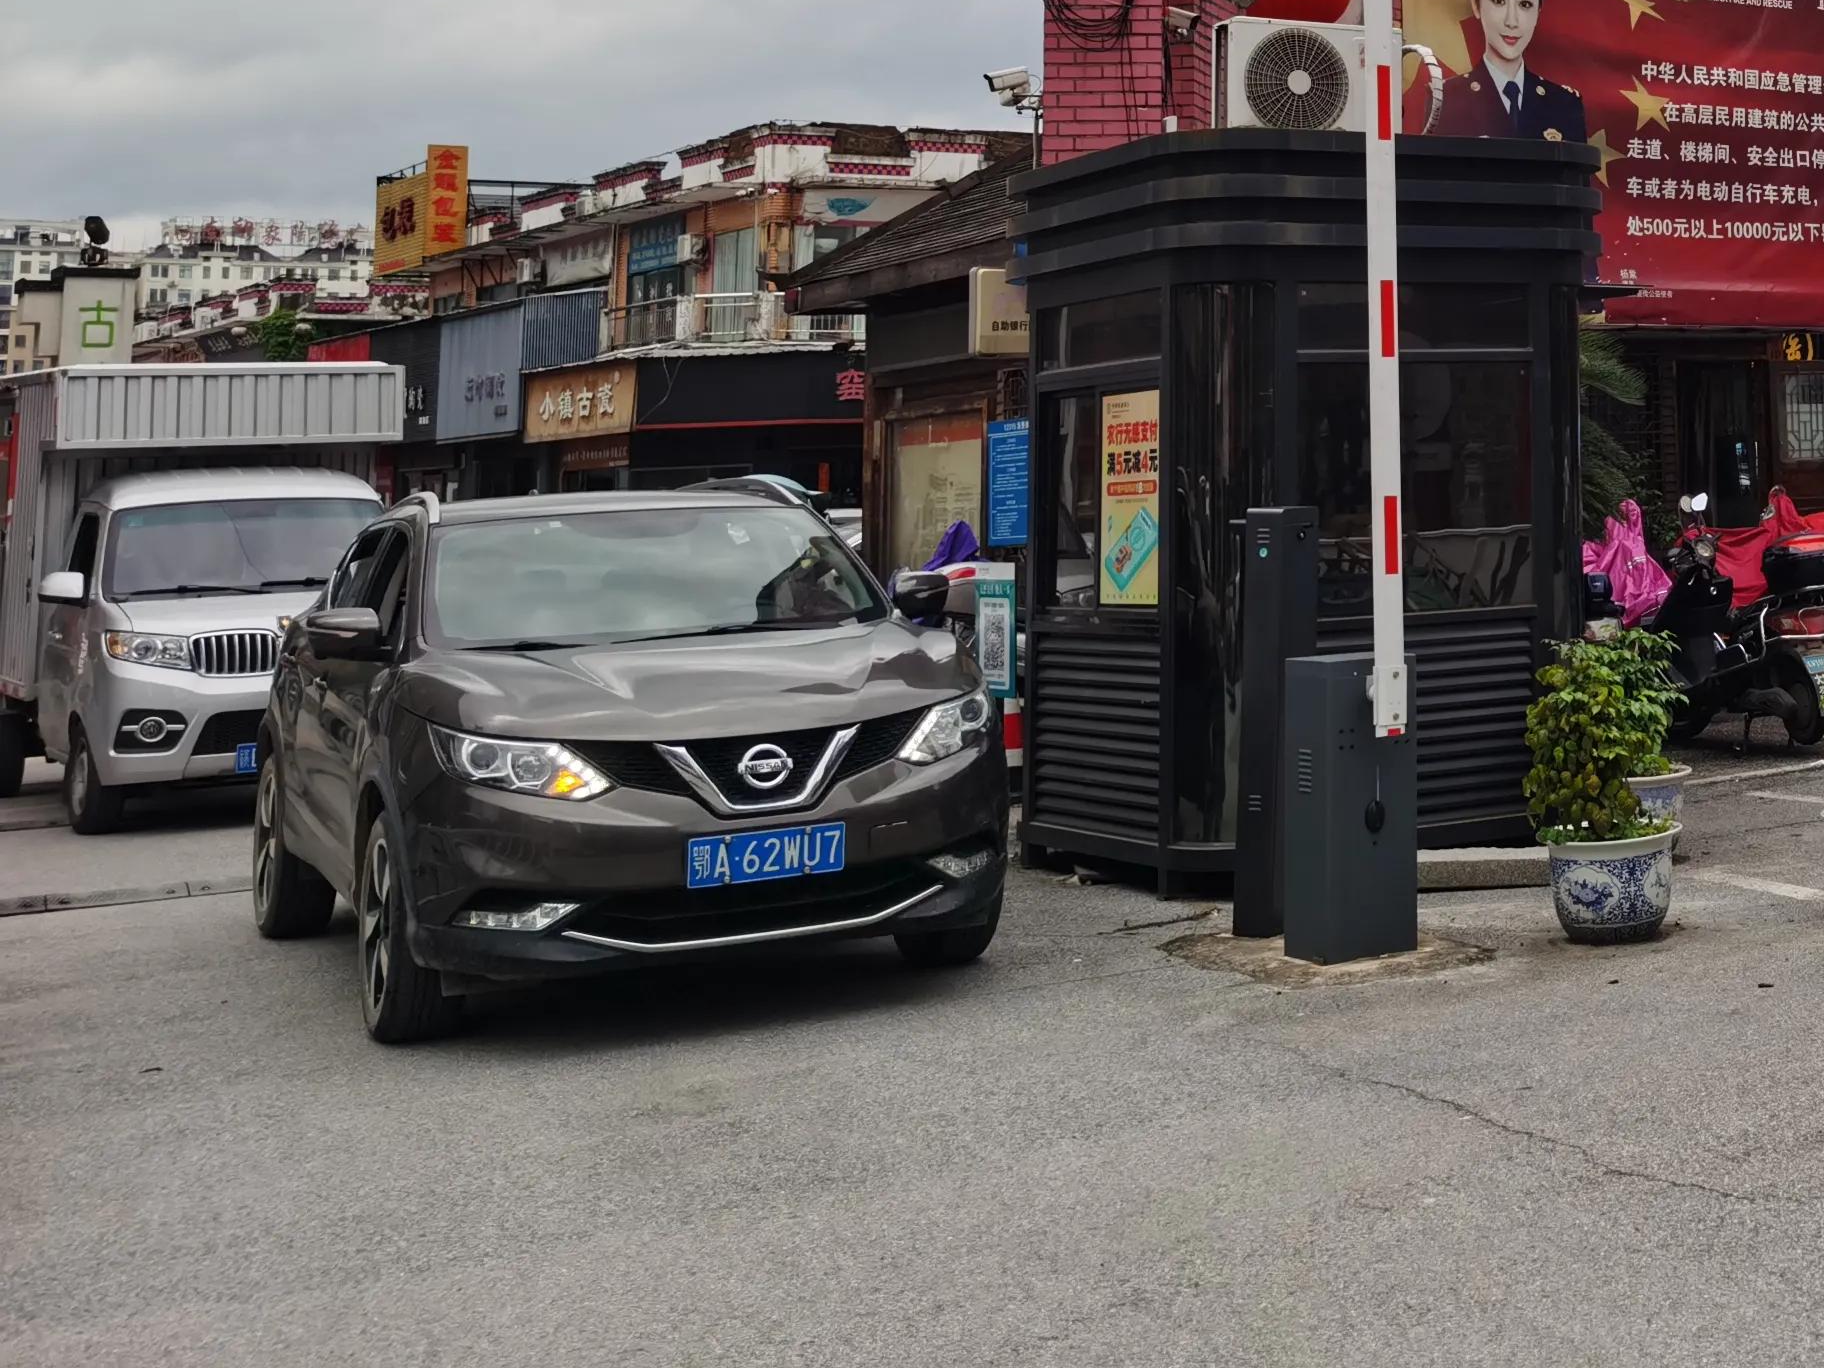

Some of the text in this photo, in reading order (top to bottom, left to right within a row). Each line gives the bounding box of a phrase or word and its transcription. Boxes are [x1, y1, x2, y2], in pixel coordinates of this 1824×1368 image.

[79, 299, 119, 348] 古
[992, 320, 1030, 332] 自助银行
[539, 382, 614, 422] 小镇古瓷
[1107, 419, 1158, 446] 农行无感支付
[1107, 448, 1159, 476] 满5元减4元
